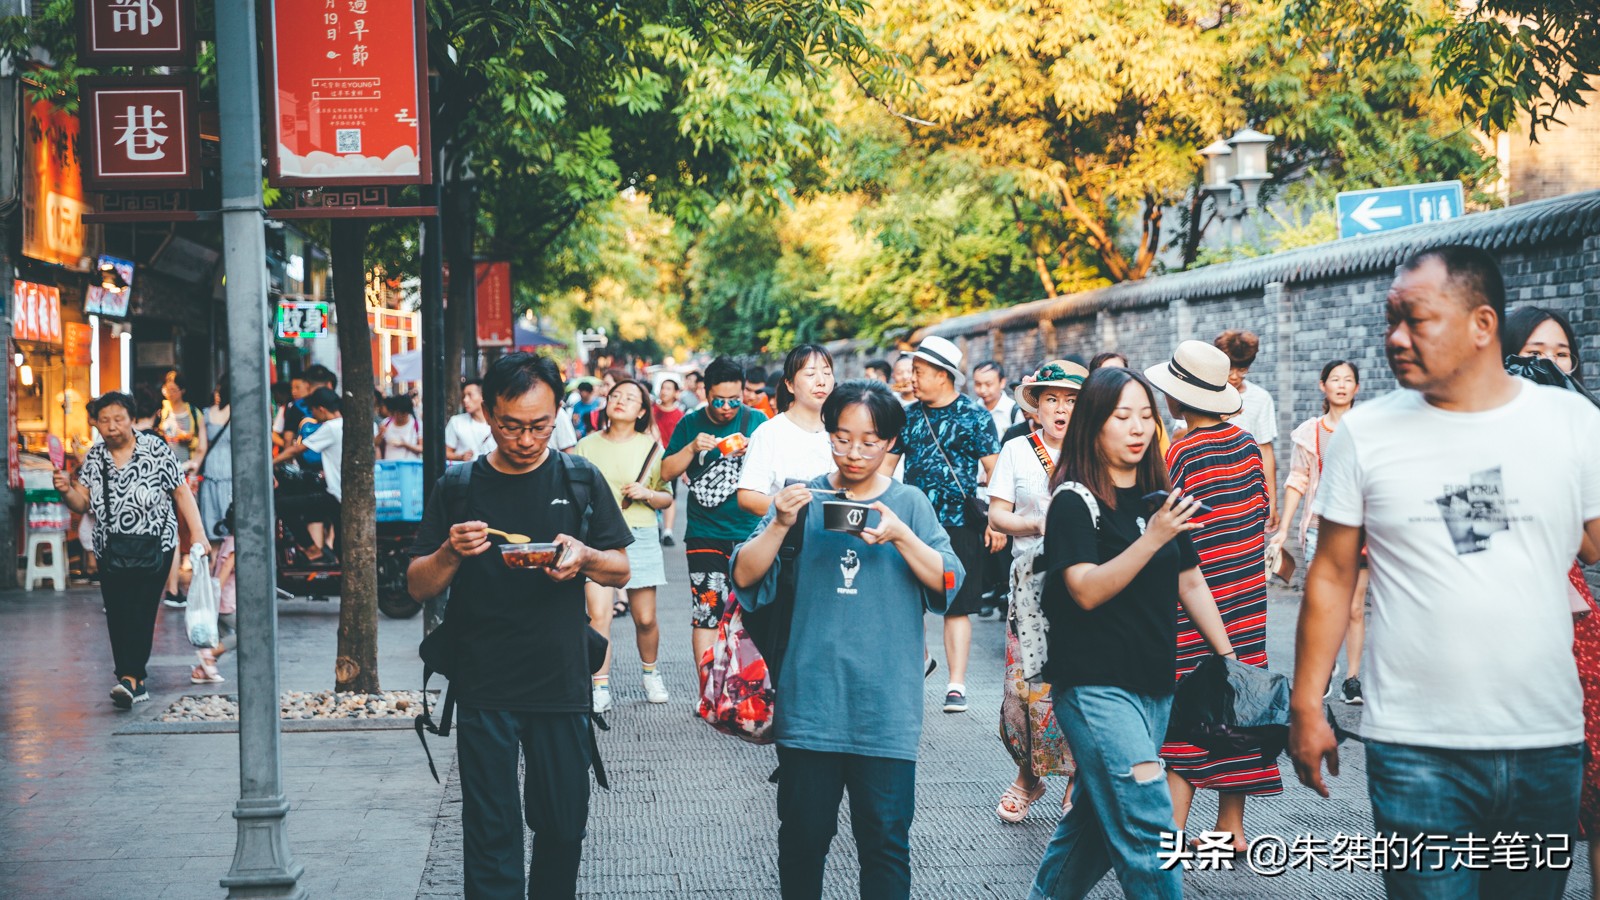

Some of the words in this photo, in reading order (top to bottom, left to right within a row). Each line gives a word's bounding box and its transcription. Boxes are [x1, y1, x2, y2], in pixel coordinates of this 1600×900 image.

[113, 105, 169, 161] 巷
[283, 307, 322, 332] 纹身
[1034, 445, 1051, 464] LOVE
[1443, 484, 1499, 496] EUPHORIA
